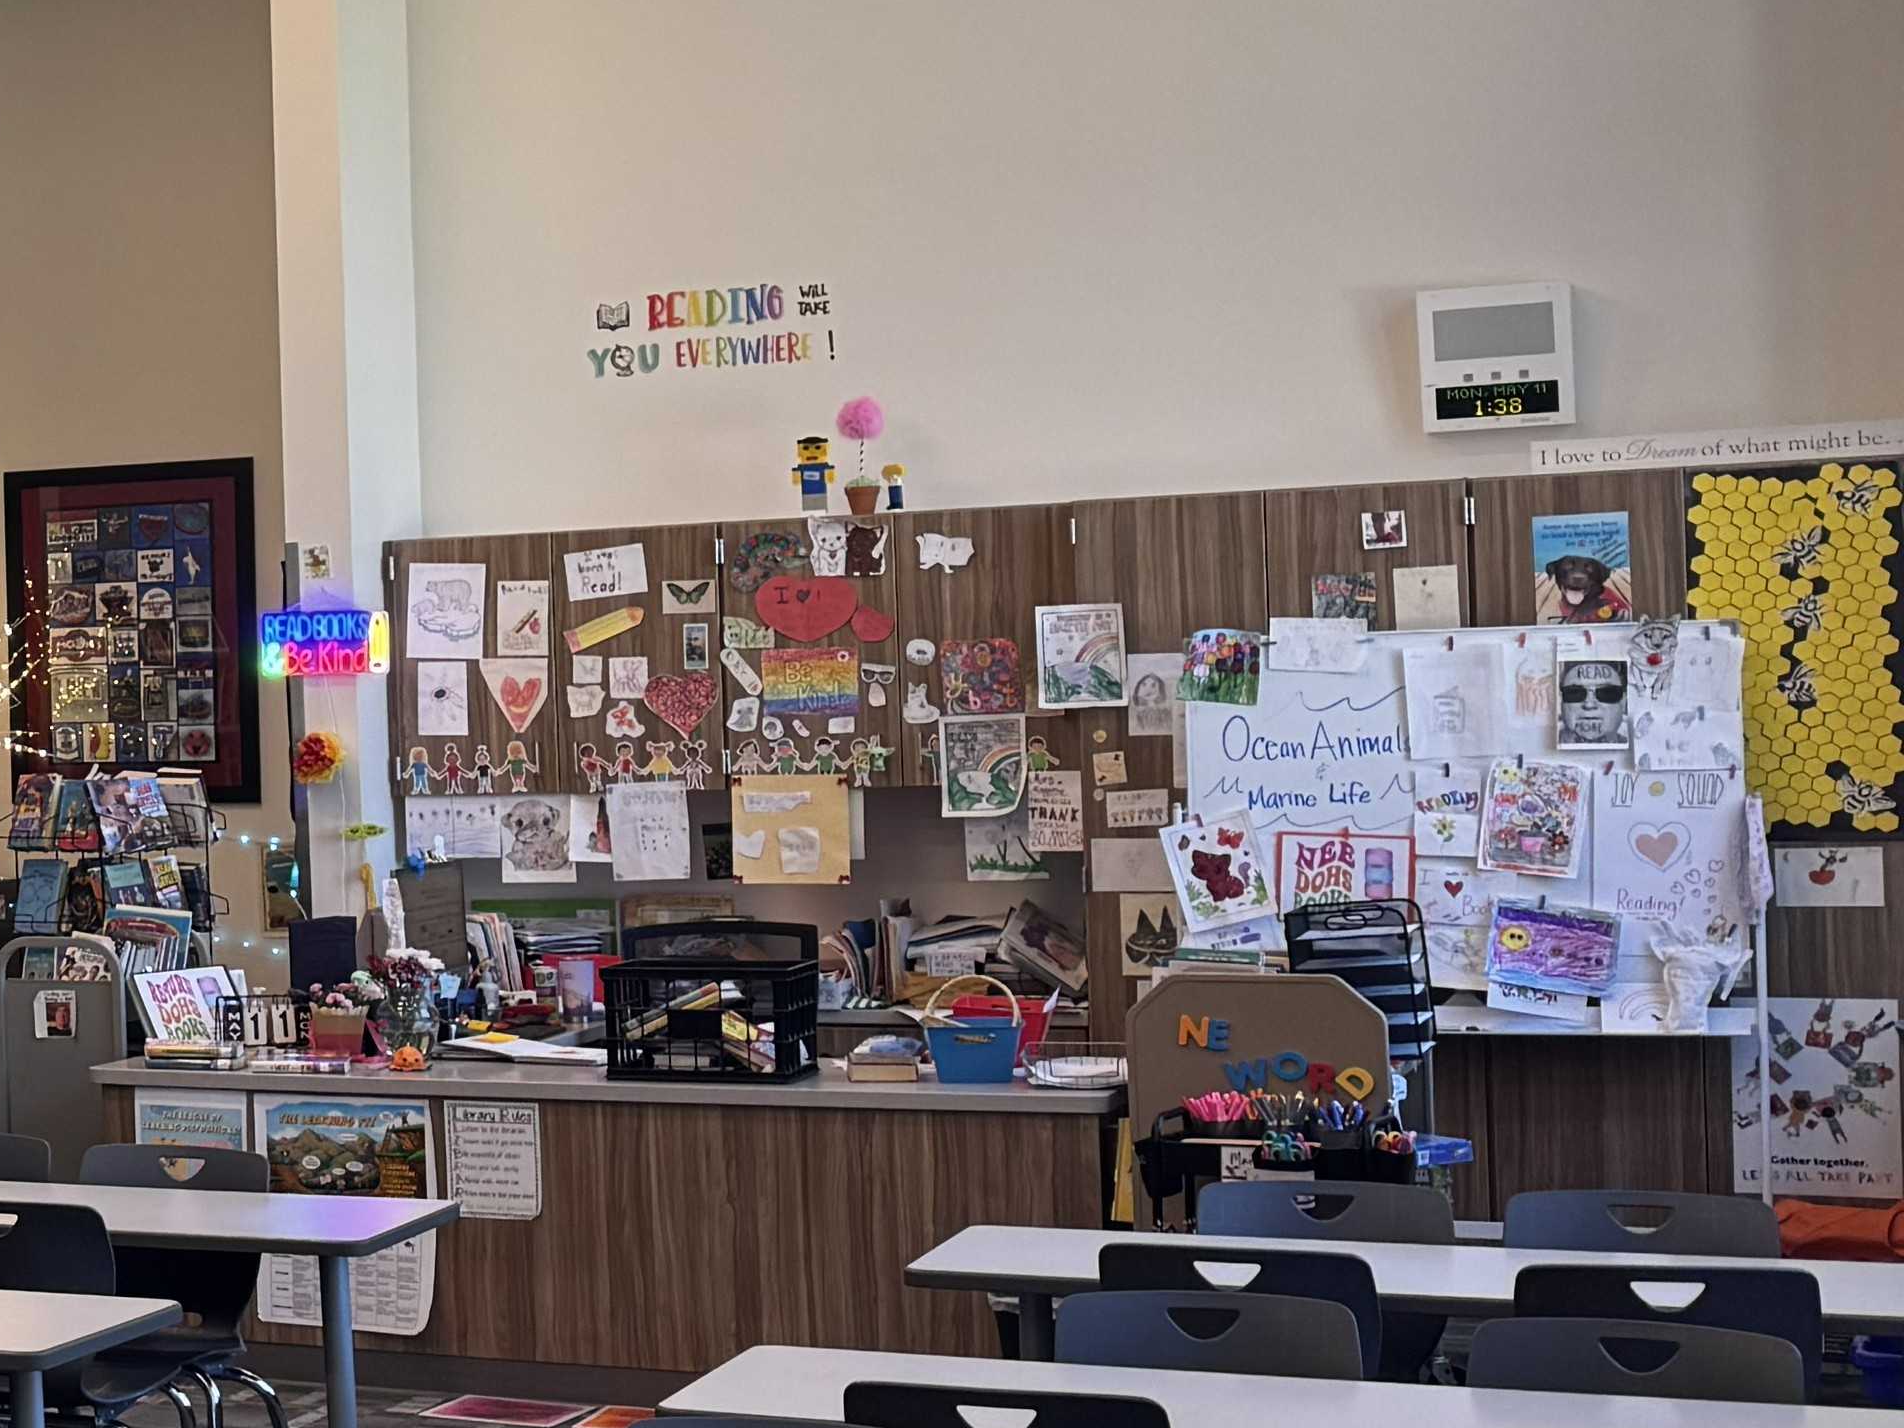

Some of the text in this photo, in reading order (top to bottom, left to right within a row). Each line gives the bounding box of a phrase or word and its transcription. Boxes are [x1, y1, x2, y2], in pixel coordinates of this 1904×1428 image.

[798, 283, 829, 300] WILL
[646, 283, 785, 331] READING
[797, 300, 831, 317] TAKE
[1493, 382, 1548, 397] MAY 11
[1474, 397, 1523, 416] 1:38
[1540, 429, 1851, 465] I love to Dream of what might
[582, 572, 622, 594] Read!
[263, 612, 370, 643] READ BOOKS
[261, 639, 369, 675] & Be Kind
[1577, 665, 1612, 680] READ
[1222, 714, 1306, 763] Ocean
[1248, 782, 1373, 811] Marine Life
[1611, 773, 1640, 806] JOY
[1295, 840, 1356, 868] NEE
[1295, 865, 1354, 895] DOHS
[1615, 888, 1686, 921] Reading!
[227, 1012, 241, 1041] MAY
[1177, 1014, 1231, 1052] NE
[1222, 1050, 1376, 1100] WORD
[453, 1102, 532, 1125] Library Rules
[1770, 1155, 1869, 1169] Gather together.
[1785, 1170, 1810, 1182] ALL
